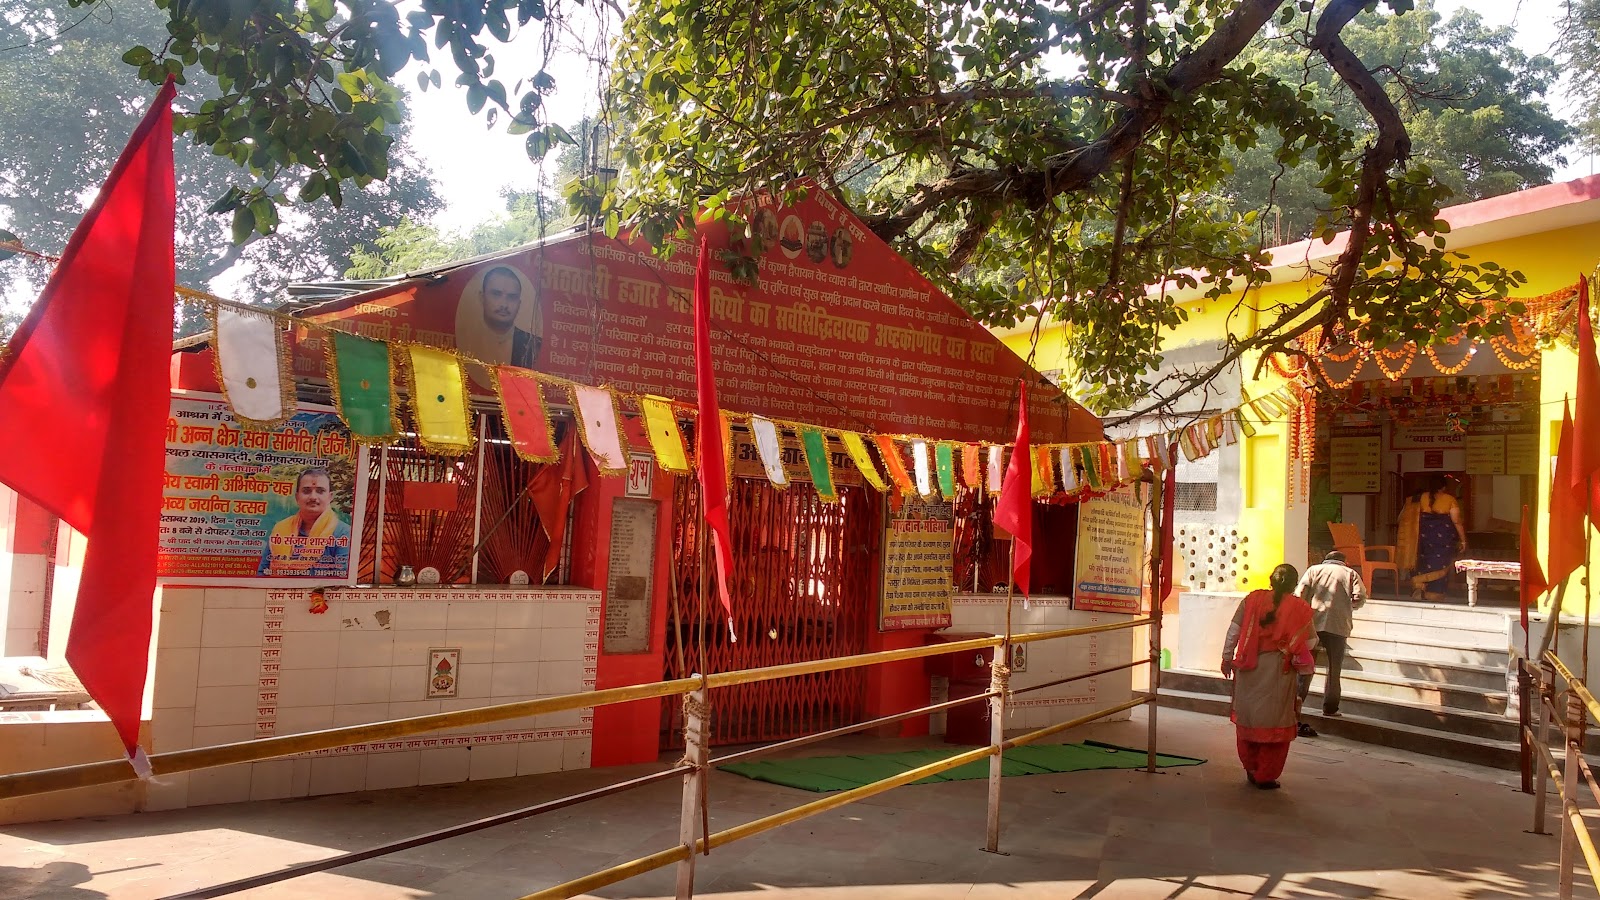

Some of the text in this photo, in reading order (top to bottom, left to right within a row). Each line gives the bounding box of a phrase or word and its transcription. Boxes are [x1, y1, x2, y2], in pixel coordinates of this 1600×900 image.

[816, 269, 827, 282] वेद
[828, 274, 847, 287] व्यास
[848, 276, 858, 289] जी
[803, 288, 819, 303] सुख
[354, 302, 399, 318] प्रबन्धक
[748, 300, 771, 328] का
[641, 332, 655, 345] की
[656, 335, 682, 349] मंगल
[665, 322, 682, 334] इस
[750, 336, 767, 347] नमो
[632, 347, 643, 360] में
[643, 350, 667, 363] अपने
[668, 355, 679, 365] या
[723, 360, 745, 375] किसी
[747, 364, 757, 376] भी
[759, 367, 769, 377] के
[666, 368, 674, 380] ने
[726, 377, 739, 389] की
[176, 410, 209, 420] आश्रम
[212, 412, 223, 420] में
[181, 426, 215, 445] अन्न
[217, 423, 240, 447] क्षेत्र
[272, 429, 314, 453] समिति
[205, 462, 216, 470] के
[630, 459, 650, 490] शुभ
[184, 474, 220, 491] स्वामी
[222, 475, 271, 494] अभिषेक
[272, 481, 294, 496] यज्ञ
[189, 495, 231, 513] जयन्ति
[233, 500, 267, 514] उत्सव
[211, 516, 226, 525] दिन
[179, 527, 193, 535] बजे
[195, 526, 203, 535] से
[237, 529, 250, 537] बजे
[284, 534, 308, 546] संजय
[336, 536, 348, 547] जी
[265, 621, 282, 629] राम
[265, 635, 282, 643] राम
[263, 664, 280, 672] राम
[261, 678, 277, 686] राम
[258, 707, 275, 715] राम
[258, 721, 276, 729] राम
[352, 744, 367, 752] राम
[406, 740, 420, 748] राम
[423, 739, 437, 747] राम
[441, 738, 455, 746] राम
[490, 734, 503, 742] राम
